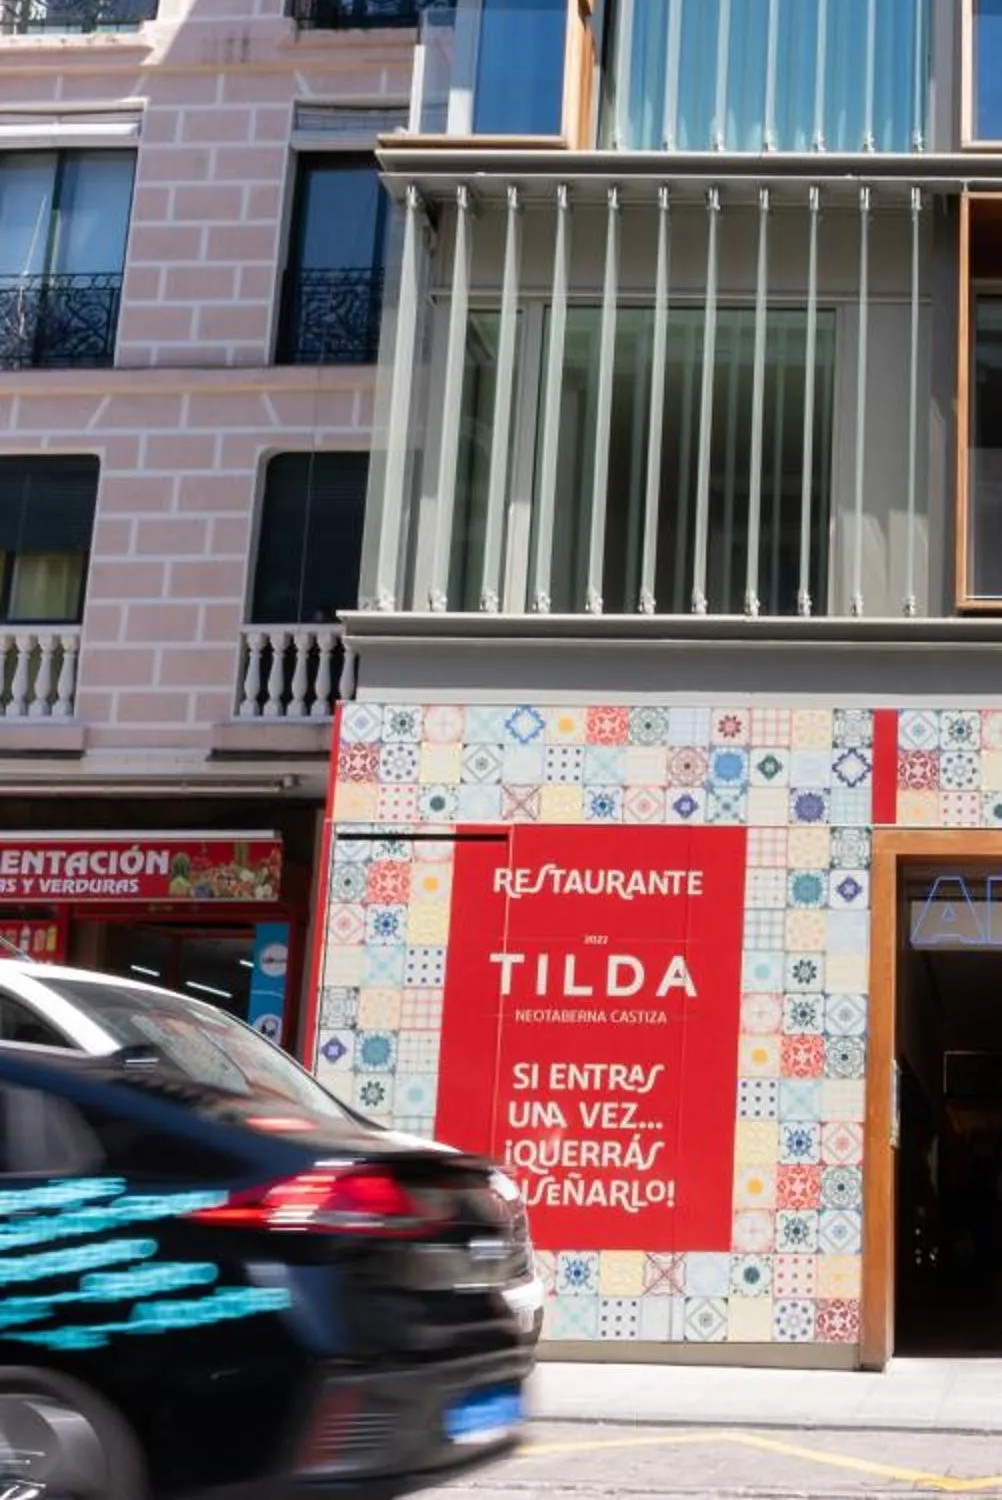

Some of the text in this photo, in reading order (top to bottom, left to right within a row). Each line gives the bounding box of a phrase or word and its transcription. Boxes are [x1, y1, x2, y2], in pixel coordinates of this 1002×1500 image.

[22, 878, 35, 894] Y
[39, 878, 139, 894] VERDURAS
[493, 863, 704, 900] RESTAURANTE
[489, 953, 698, 997] TILDA
[514, 1008, 668, 1024] NEOTABERNA CASTIZA
[512, 1062, 665, 1093] SI ENTRAS
[507, 1100, 663, 1130] UNA VEZ...
[504, 1133, 665, 1175] ¡QUERRÁS
